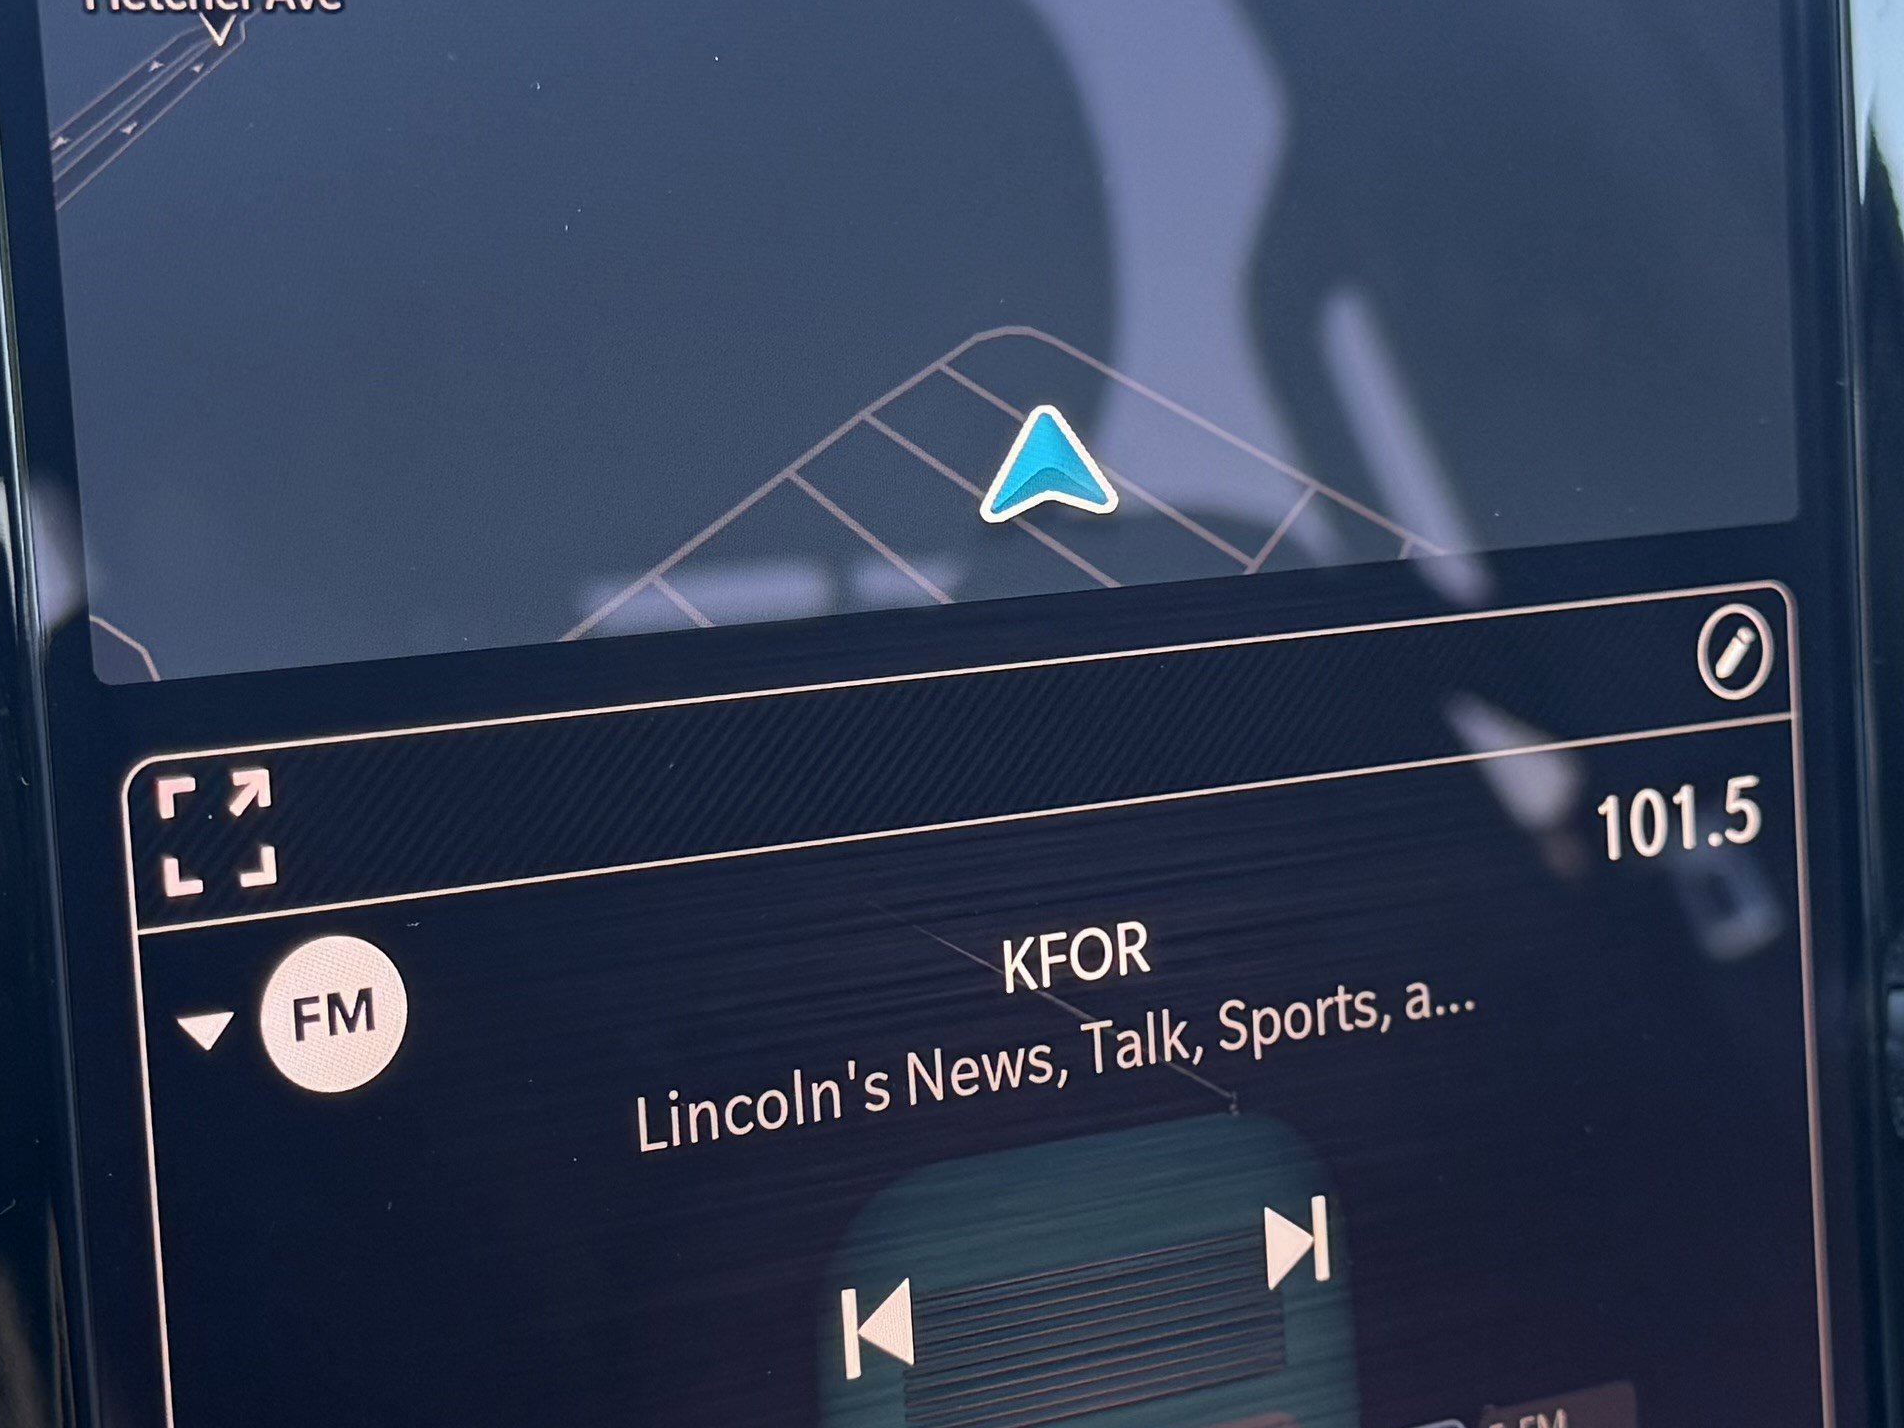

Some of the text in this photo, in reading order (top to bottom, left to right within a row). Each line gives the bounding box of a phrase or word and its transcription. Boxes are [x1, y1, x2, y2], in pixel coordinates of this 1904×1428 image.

[1597, 775, 1762, 861] 101.5
[1002, 921, 1151, 994] KFOR
[293, 986, 376, 1042] FM
[637, 1060, 891, 1153] Lincoln's
[906, 1044, 1068, 1106] News,
[1080, 1009, 1203, 1075] Talk,
[1219, 984, 1391, 1060] Sports,
